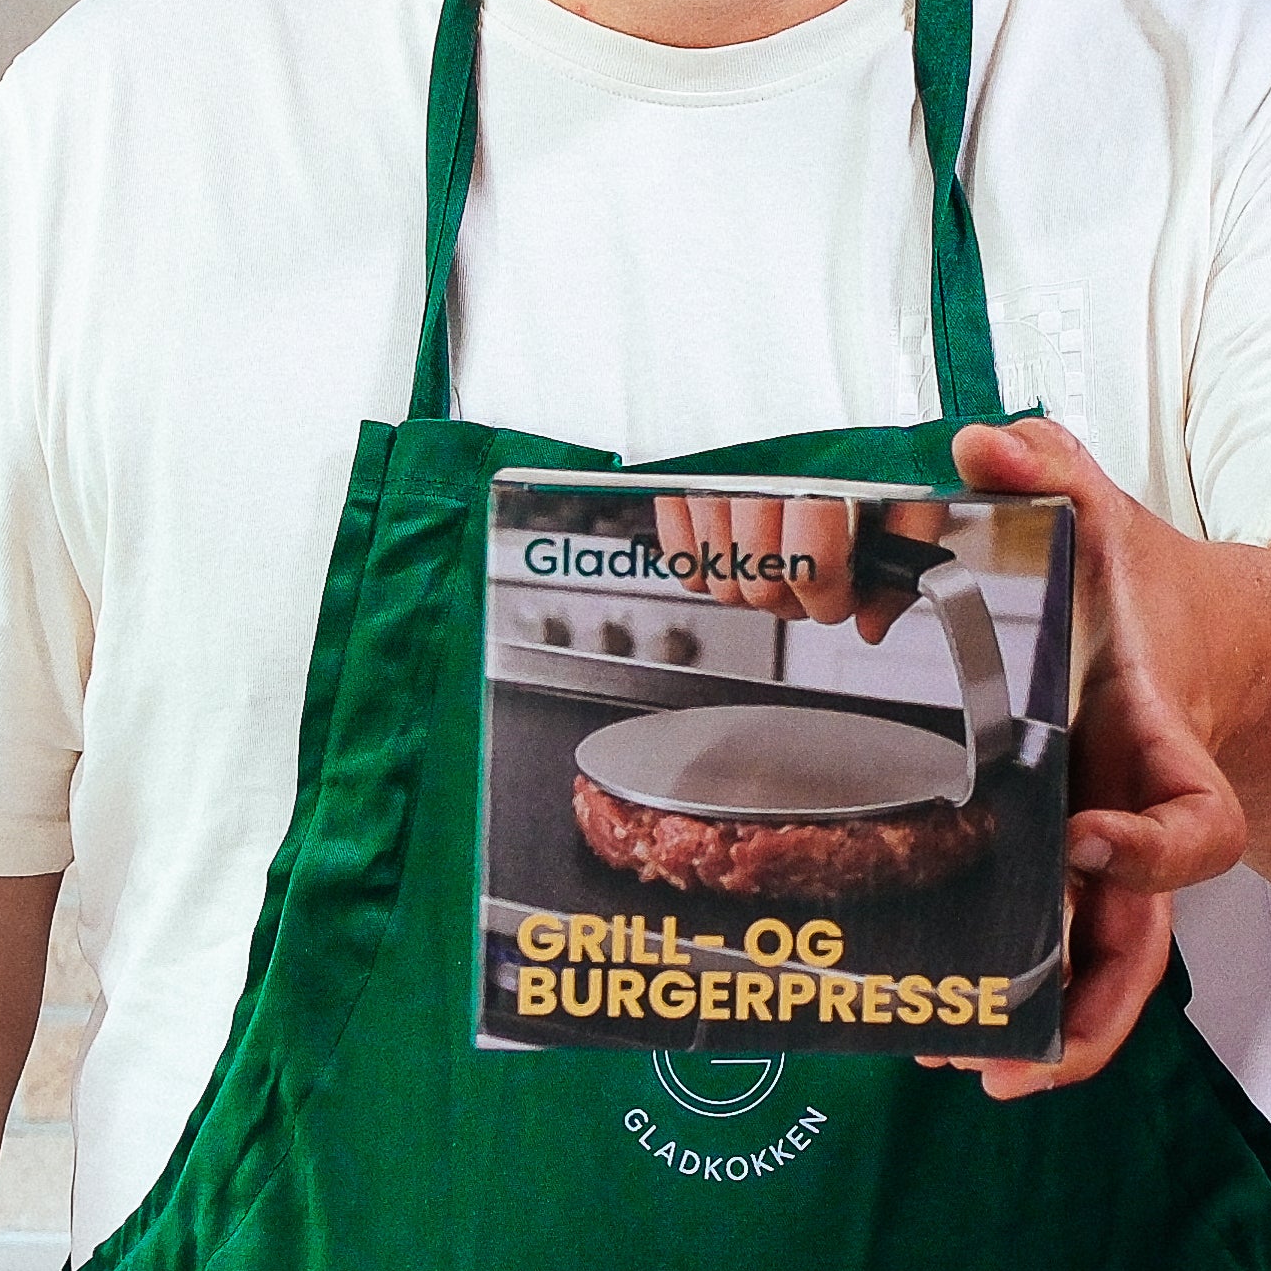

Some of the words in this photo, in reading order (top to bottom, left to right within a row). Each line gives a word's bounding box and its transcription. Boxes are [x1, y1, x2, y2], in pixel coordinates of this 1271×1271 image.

[524, 534, 818, 582] Gladkokken
[516, 913, 725, 966] GRILL-
[743, 917, 845, 969] OG
[516, 966, 1012, 1026] BURGERPRESSE
[624, 1106, 828, 1182] GLADKOKKEN
